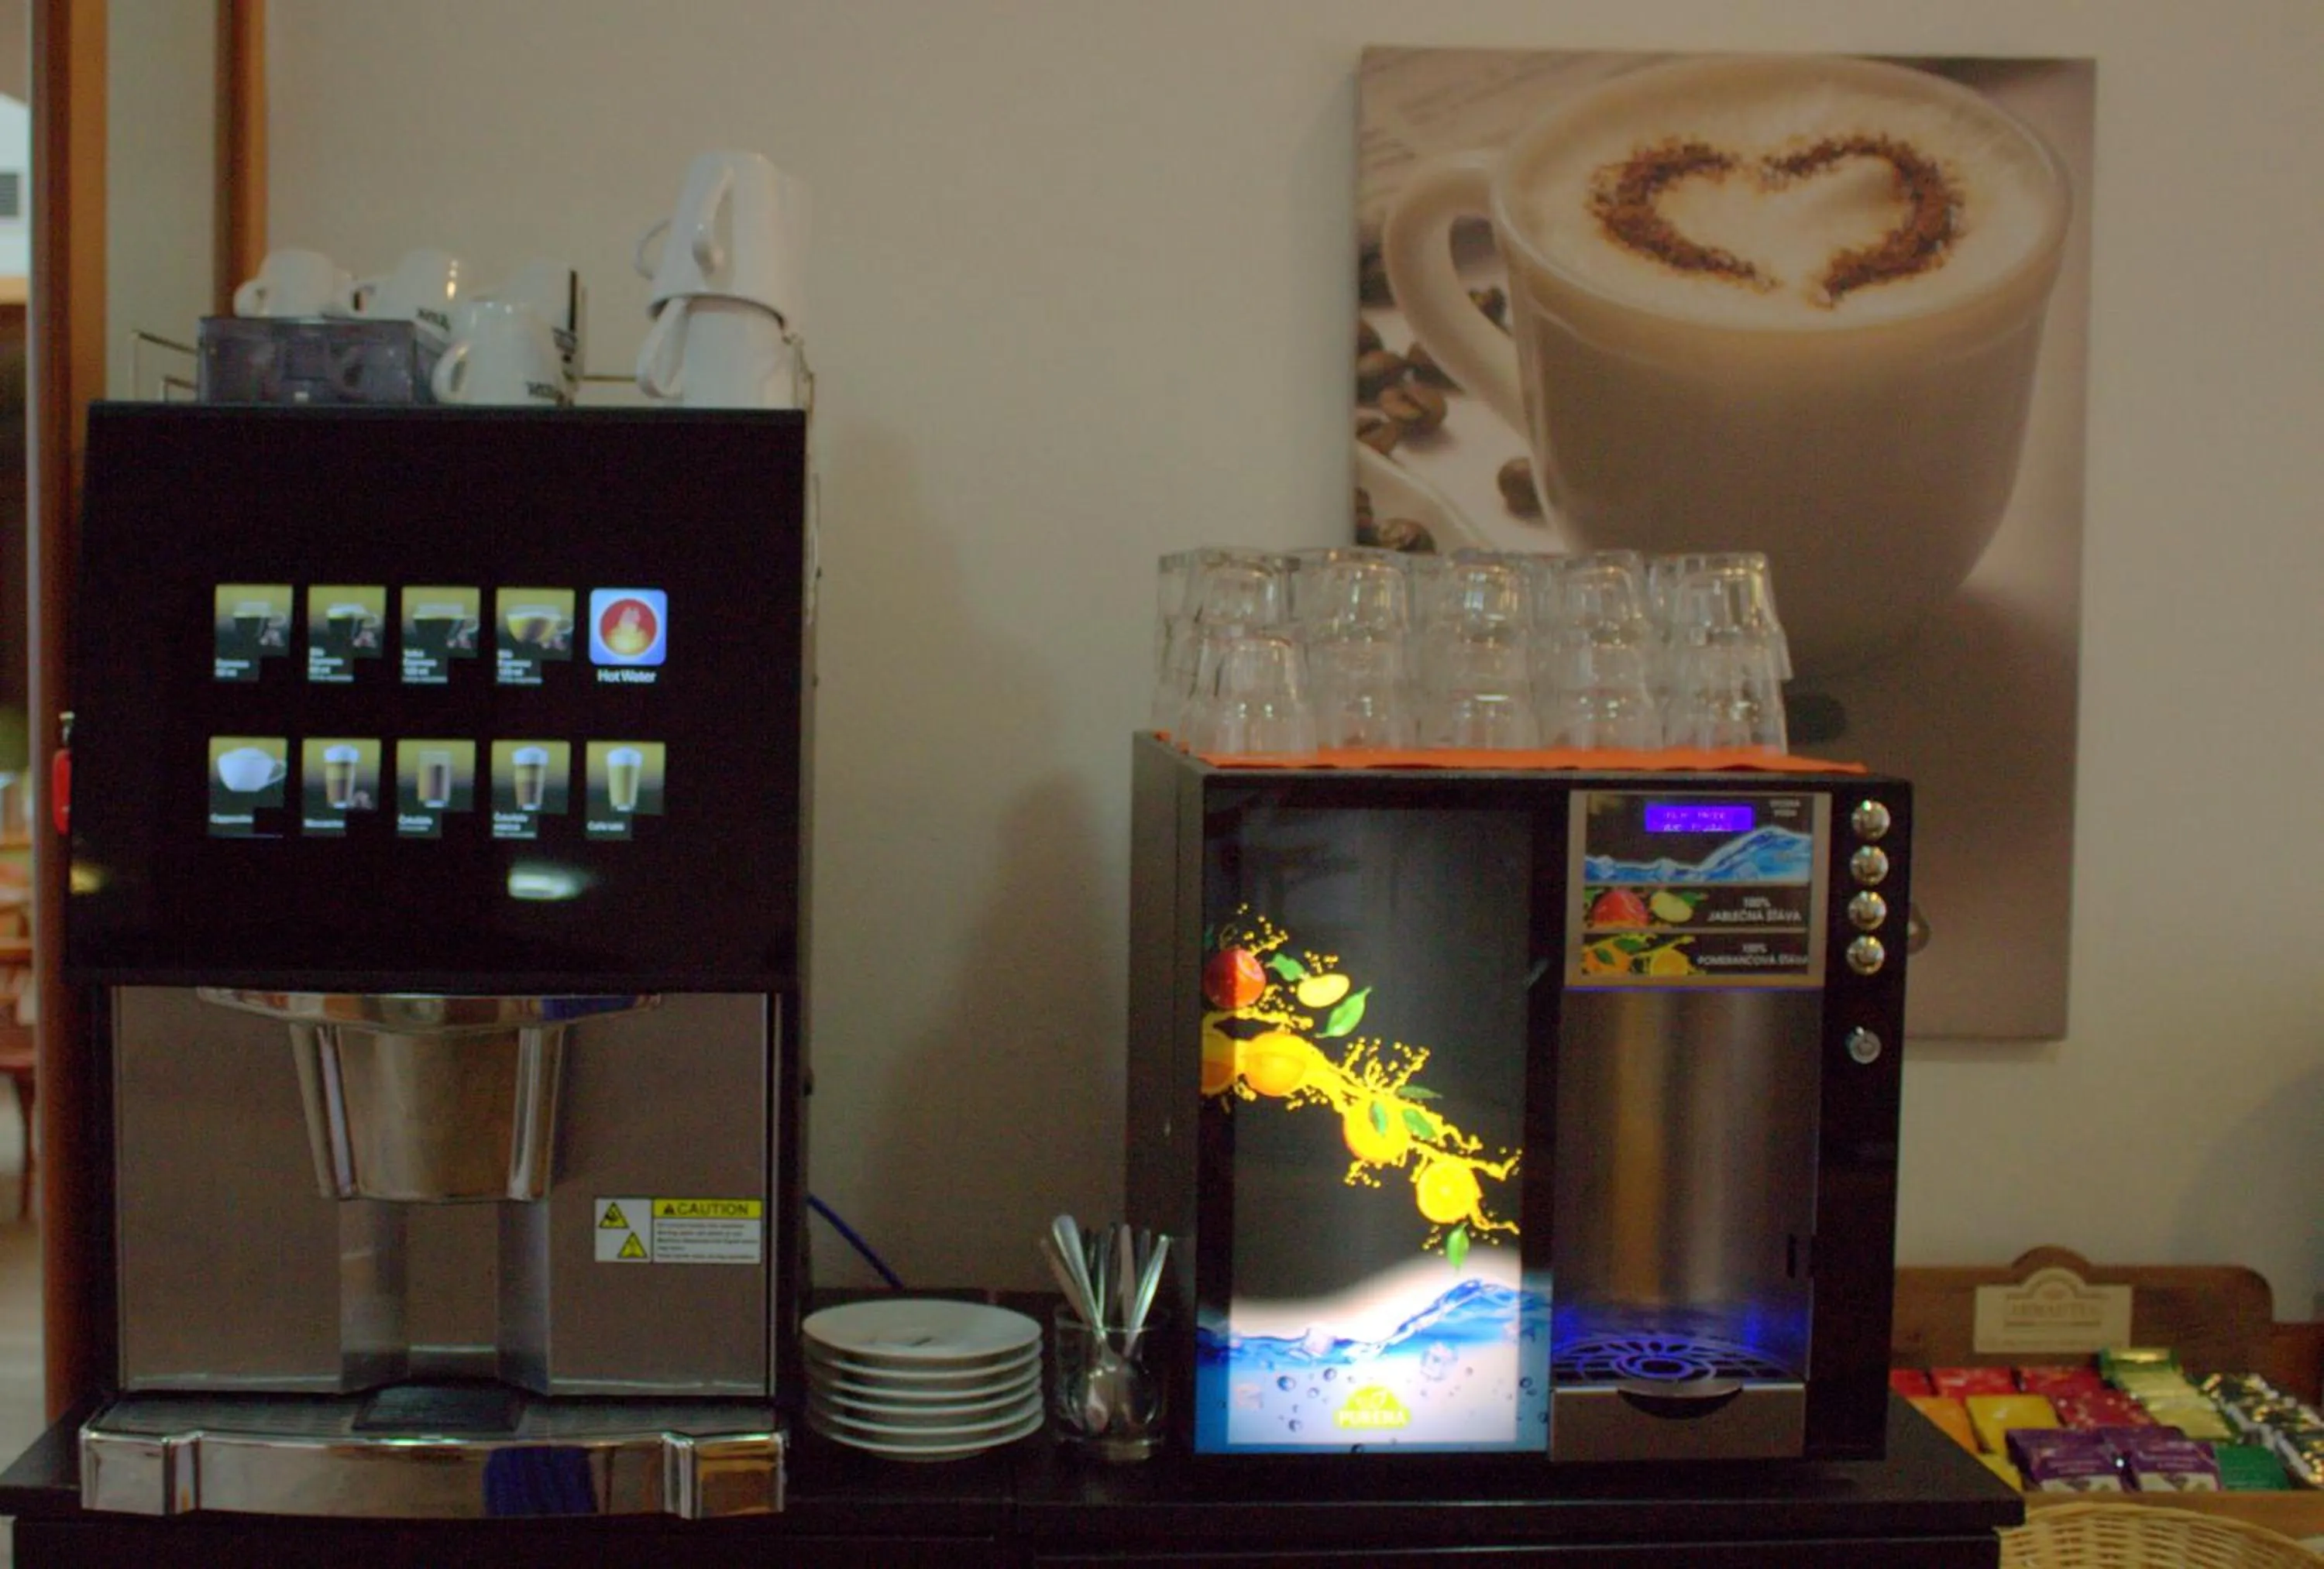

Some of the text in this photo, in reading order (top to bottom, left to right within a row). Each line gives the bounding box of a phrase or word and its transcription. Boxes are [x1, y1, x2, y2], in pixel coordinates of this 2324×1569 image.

[597, 669, 657, 683] Hot Water
[677, 1203, 748, 1216] CAUTION
